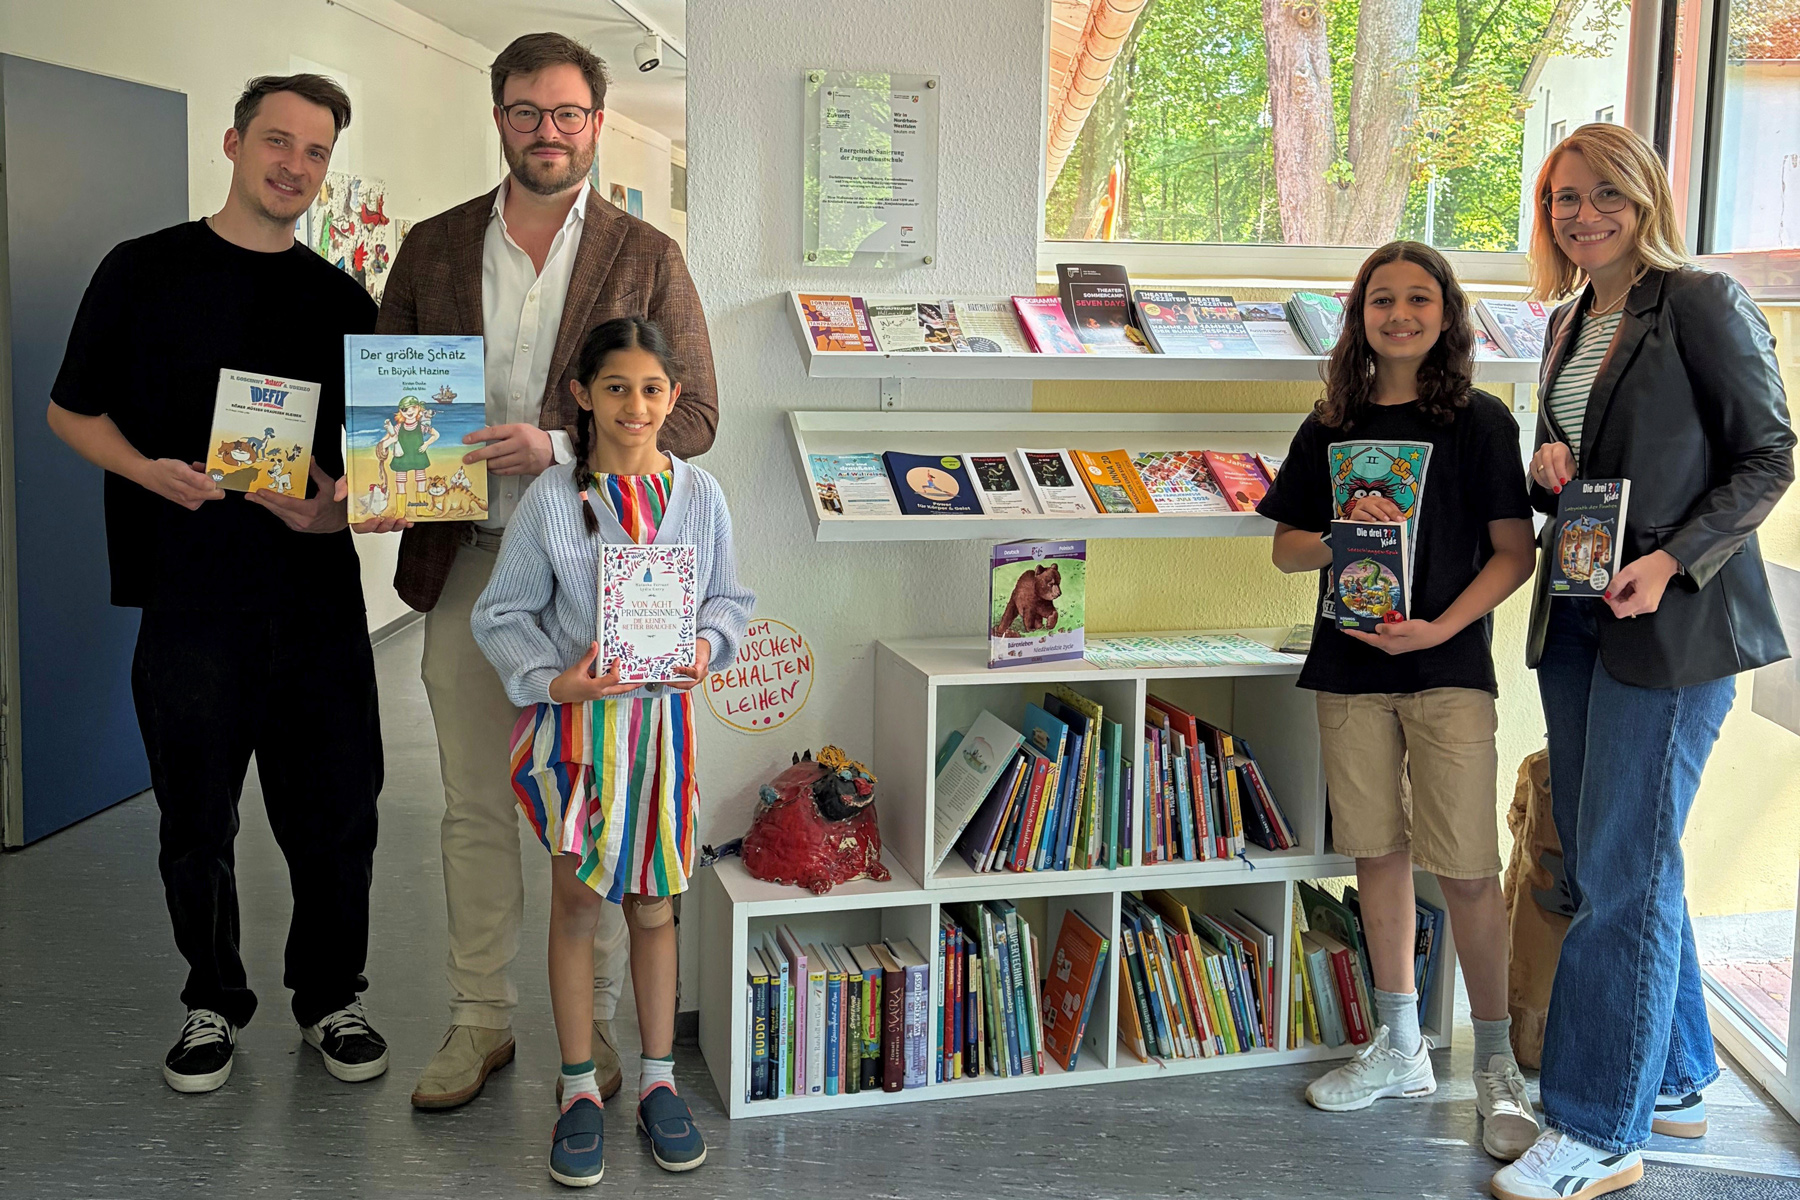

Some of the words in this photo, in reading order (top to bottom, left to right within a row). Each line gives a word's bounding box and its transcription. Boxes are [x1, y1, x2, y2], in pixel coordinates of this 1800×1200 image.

[360, 348, 382, 360] Der
[386, 346, 424, 362] größte
[428, 348, 466, 362] Schatz
[378, 367, 388, 375] En
[391, 366, 417, 377] Büyük
[420, 367, 450, 375] Hazine
[1106, 466, 1121, 483] UNNA
[1583, 484, 1593, 493] Die
[1594, 483, 1606, 492] drei
[1608, 483, 1620, 492] ???
[1604, 492, 1619, 504] Kids
[1356, 528, 1367, 536] Die
[1369, 528, 1382, 537] drei
[1384, 529, 1396, 537] ???
[1381, 538, 1397, 548] Kids
[711, 655, 809, 692] BEHALTEN
[726, 679, 799, 715] LEIHEN
[1125, 932, 1135, 953] TOPP
[1004, 956, 1013, 1014] Experimente-Buch
[889, 987, 900, 1033] MARA
[756, 1016, 765, 1056] BUDDY
[1572, 1157, 1590, 1171] Reebok
